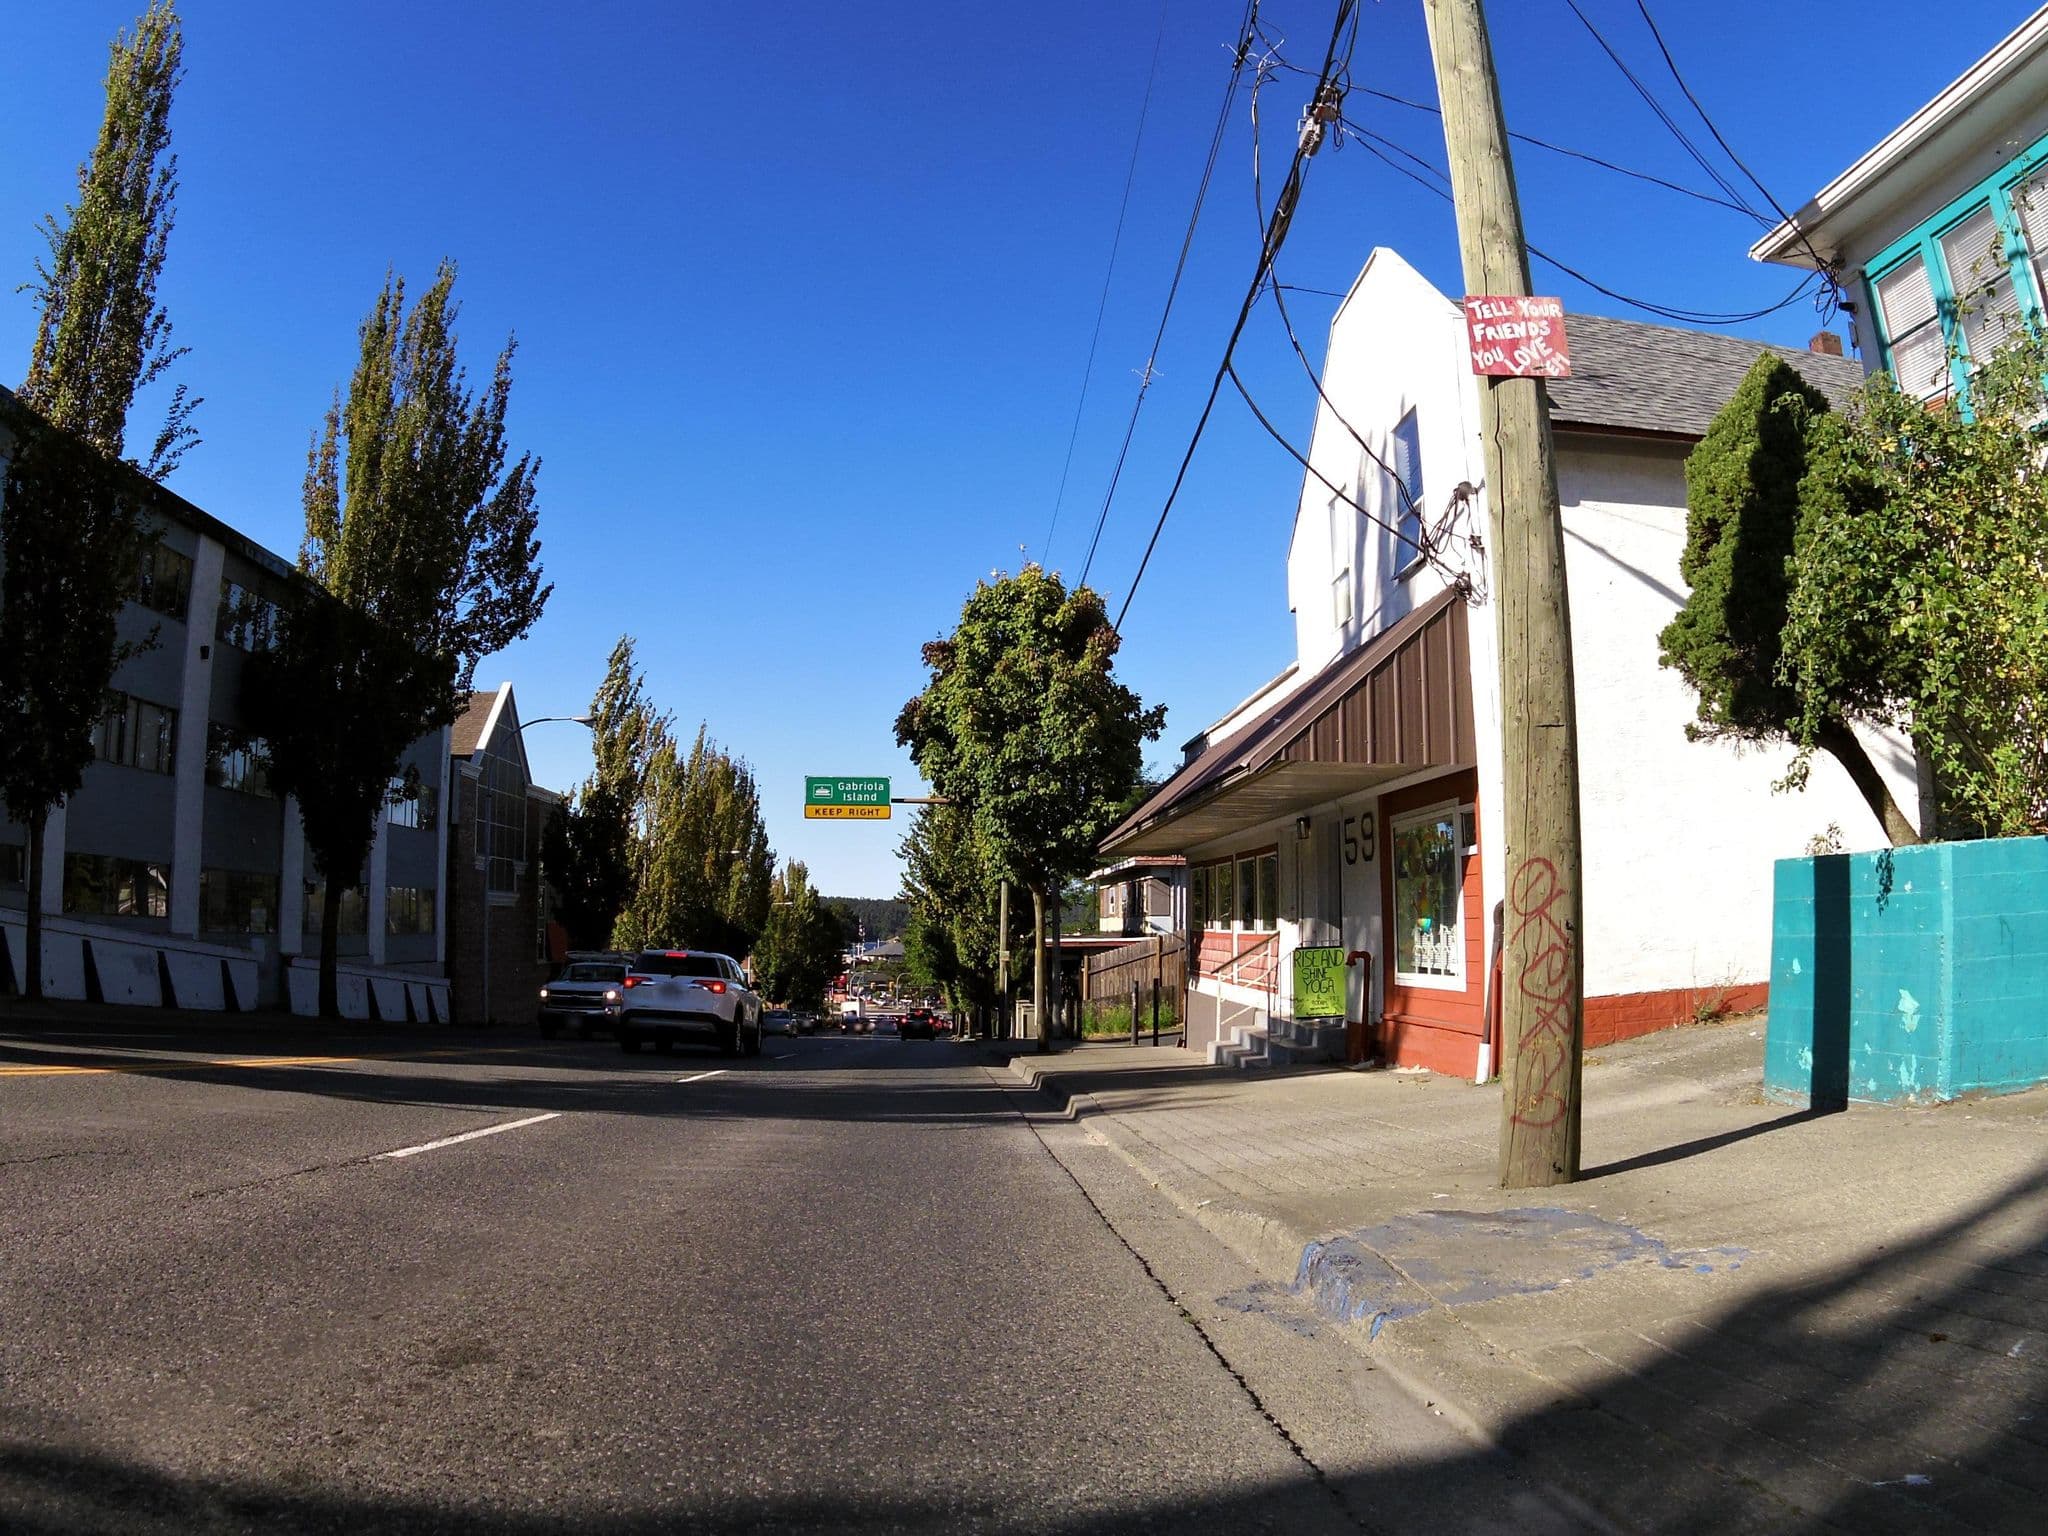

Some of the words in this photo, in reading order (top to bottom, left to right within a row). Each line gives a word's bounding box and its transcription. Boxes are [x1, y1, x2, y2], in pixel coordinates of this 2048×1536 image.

[1467, 300, 1512, 320] TELL
[1516, 299, 1563, 318] YOUR
[1472, 320, 1551, 343] FRIENDS
[1472, 346, 1504, 370] YOU
[1503, 336, 1553, 375] LOVE
[837, 782, 885, 791] Gabriola
[843, 792, 877, 801] Island
[814, 808, 843, 816] KEEP
[848, 808, 881, 816] RIGHT
[1343, 811, 1375, 866] 59
[1293, 950, 1319, 968] RISE
[1320, 949, 1345, 968] AND
[1301, 967, 1328, 980] SHINE
[1303, 979, 1335, 994] YOGA
